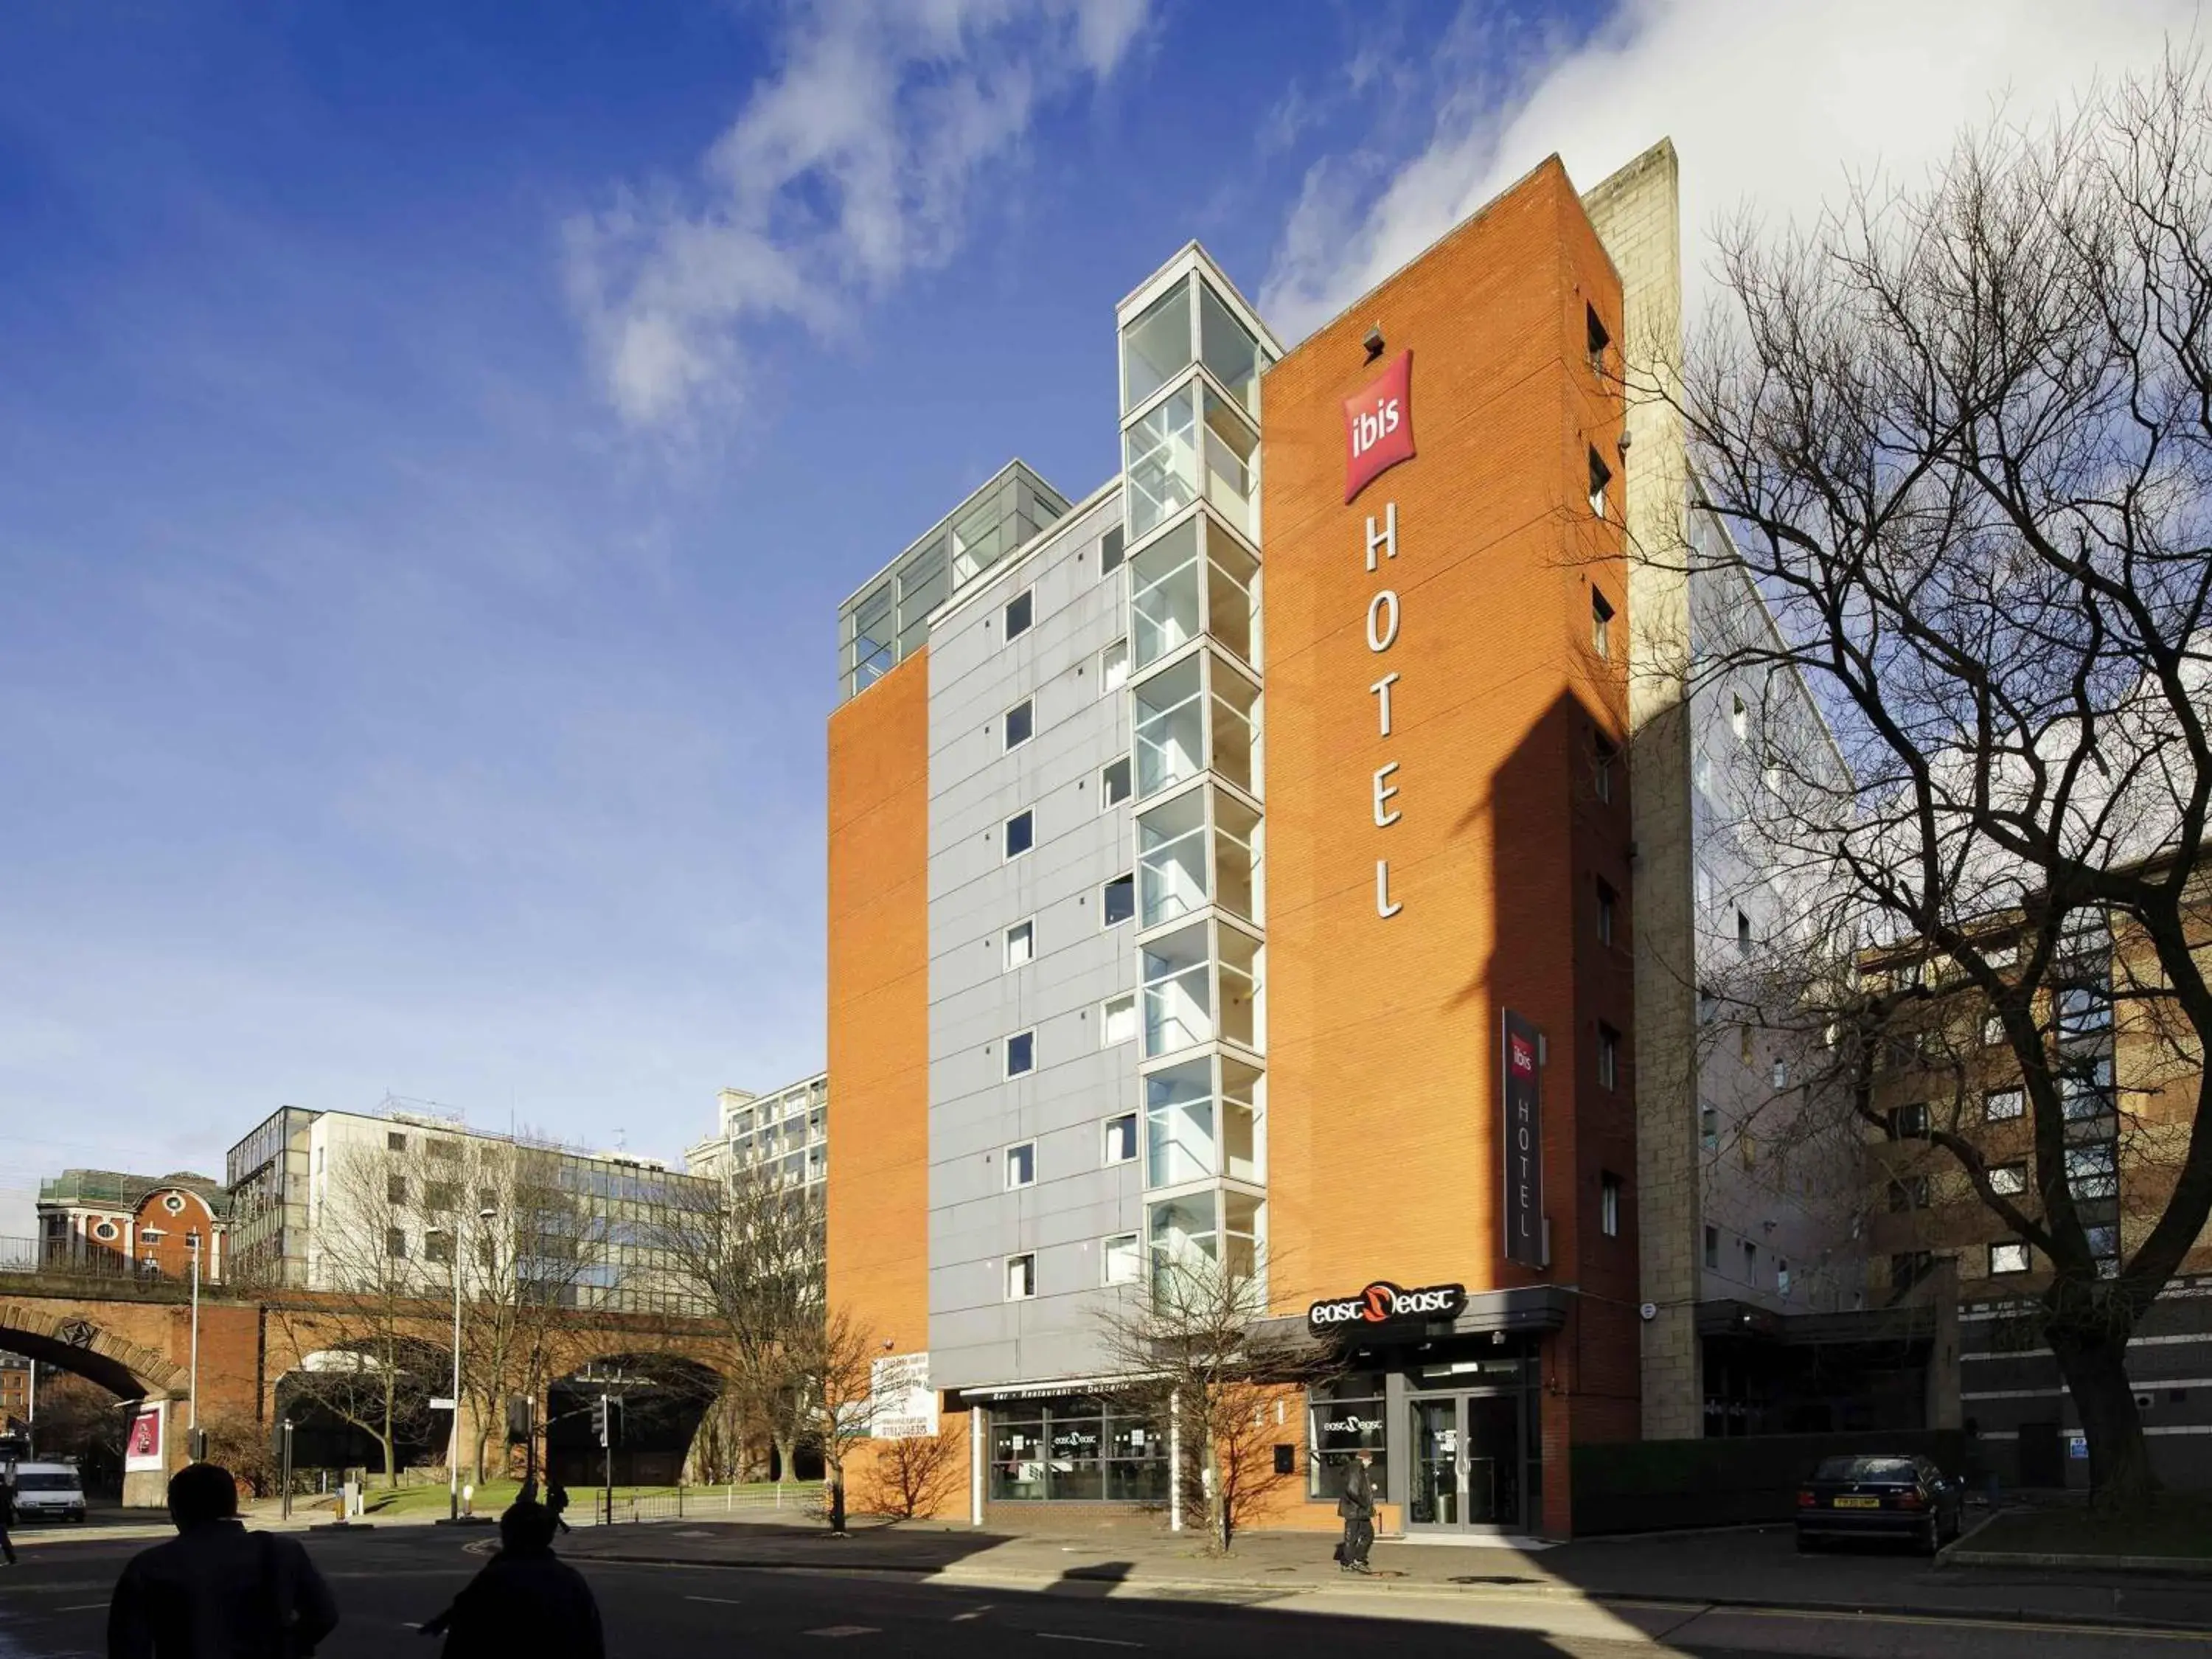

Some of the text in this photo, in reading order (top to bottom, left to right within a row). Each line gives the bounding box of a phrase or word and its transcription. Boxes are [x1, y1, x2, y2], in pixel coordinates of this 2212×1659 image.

[1352, 397, 1399, 458] ibis
[1366, 502, 1402, 918] HOTEL
[1514, 1045, 1531, 1070] ibis
[1518, 1098, 1529, 1237] HOTEL
